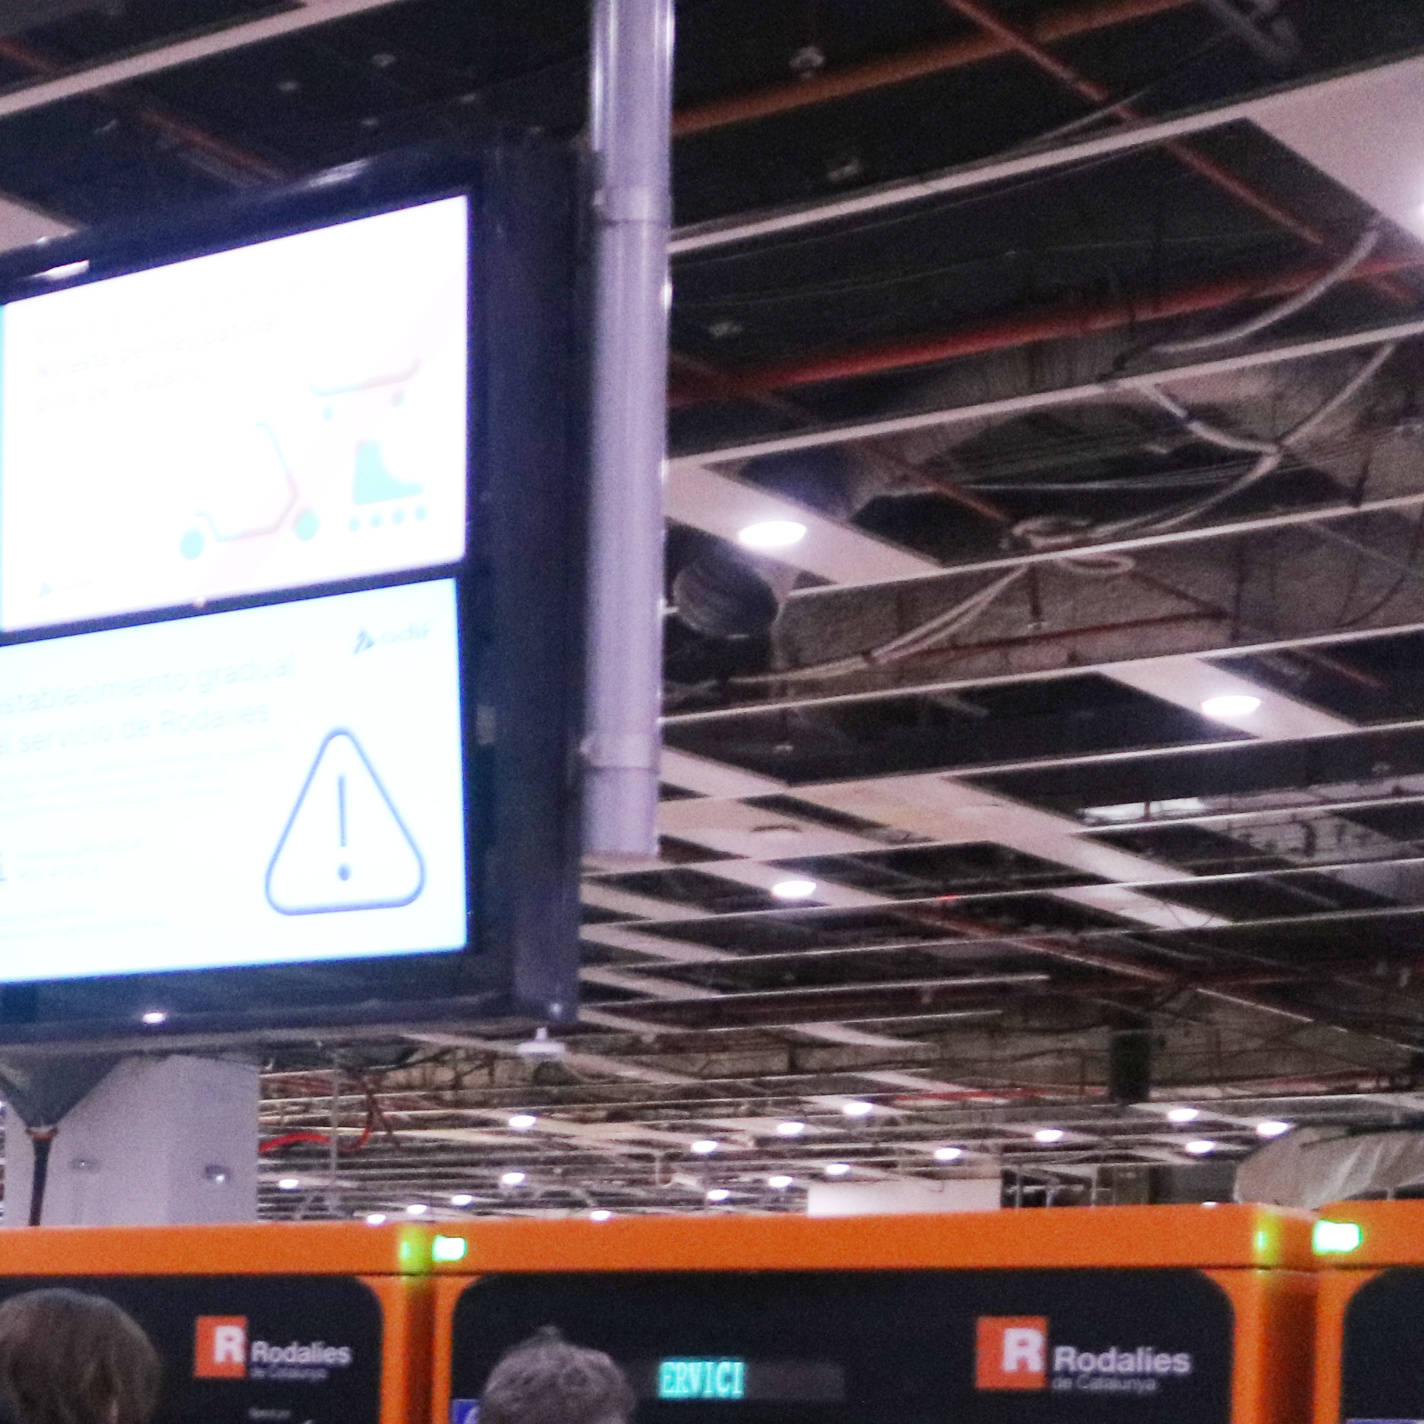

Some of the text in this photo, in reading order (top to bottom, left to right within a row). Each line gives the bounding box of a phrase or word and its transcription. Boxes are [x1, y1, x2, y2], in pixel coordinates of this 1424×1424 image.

[195, 652, 296, 695] gradual
[18, 719, 114, 754] servicio
[120, 714, 152, 740] de
[159, 701, 271, 735] Rodalies
[214, 1325, 353, 1366] R Rodalies
[1002, 1327, 1193, 1376] R Rodalies
